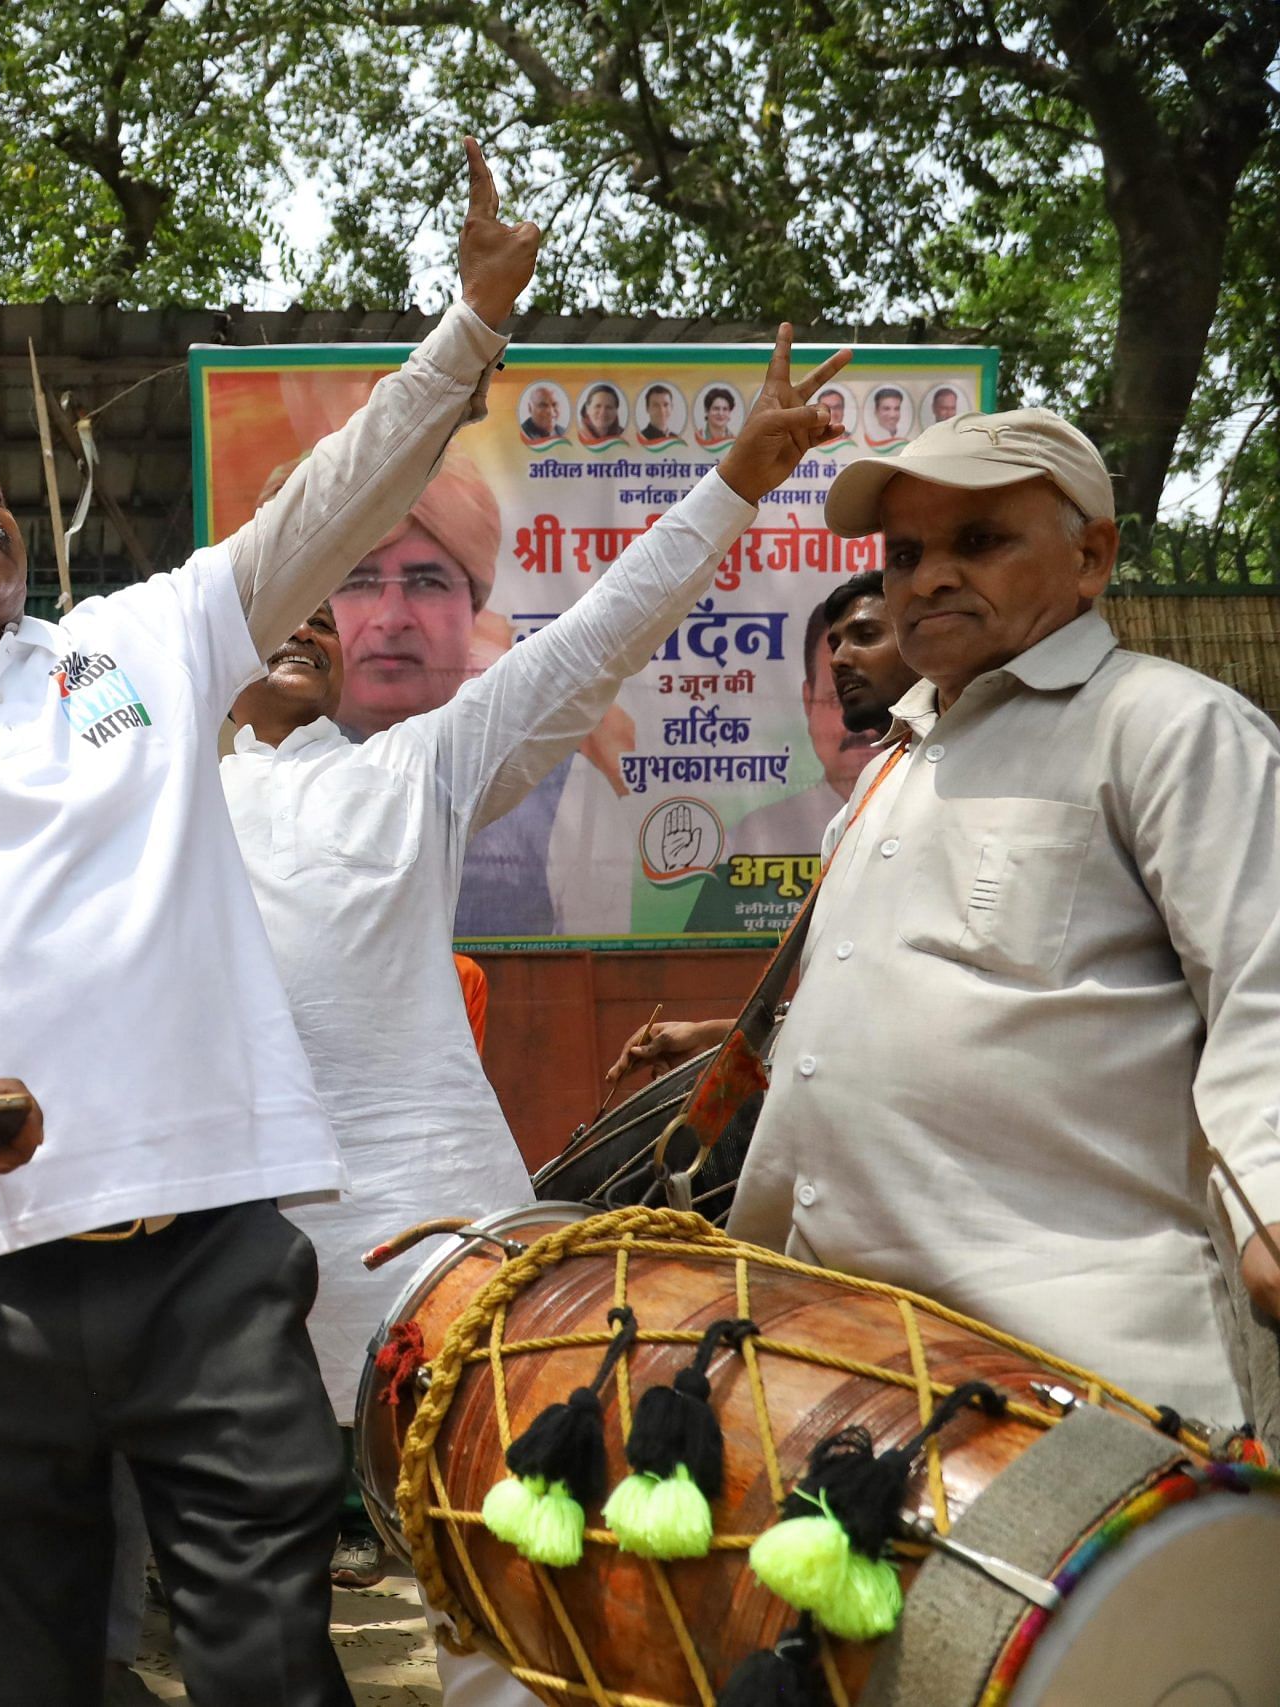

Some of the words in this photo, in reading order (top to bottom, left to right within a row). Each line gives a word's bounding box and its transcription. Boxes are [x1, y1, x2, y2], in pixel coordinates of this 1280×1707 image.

[529, 459, 581, 478] अखिल
[587, 459, 640, 478] भारतीय
[646, 457, 691, 479] कांग्रेस
[619, 484, 677, 504] कर्नाटक
[513, 513, 565, 573] श्री
[66, 654, 117, 691] JODO
[659, 675, 672, 694] 3
[679, 675, 720, 700] जून
[724, 669, 755, 694] की
[81, 704, 144, 749] YATRA
[663, 705, 751, 748] हार्दिक
[622, 747, 789, 793] शुभकामनाएं
